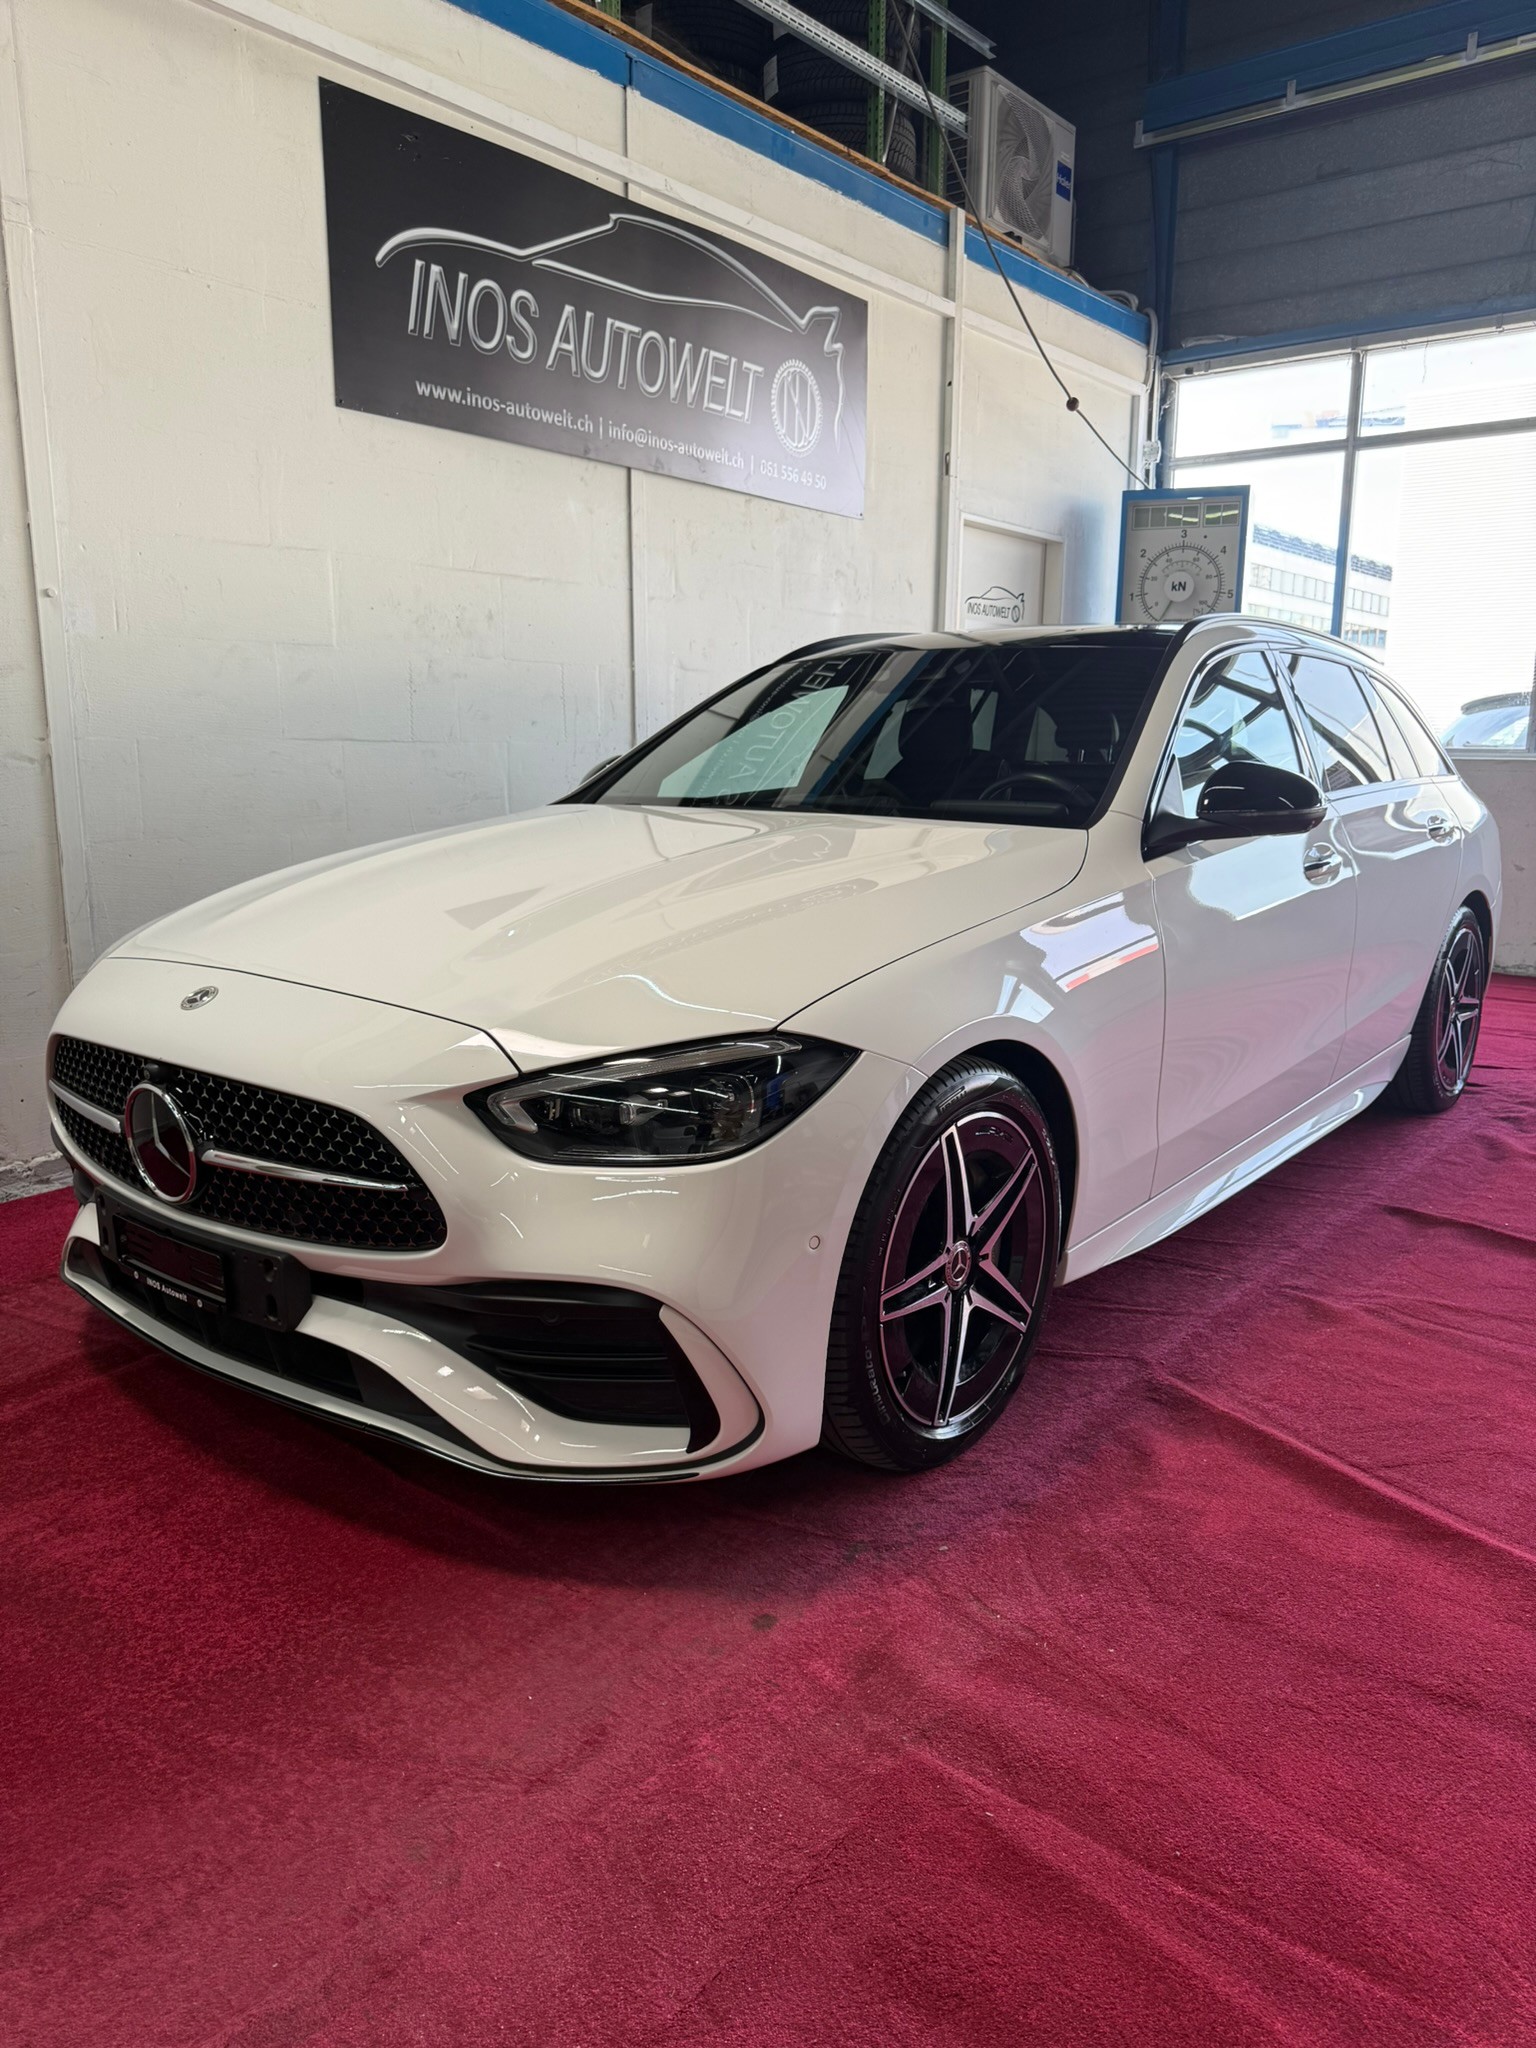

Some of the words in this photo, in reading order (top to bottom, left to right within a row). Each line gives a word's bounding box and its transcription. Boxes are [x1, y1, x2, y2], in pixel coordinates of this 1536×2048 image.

[408, 259, 539, 364] INOS
[546, 304, 765, 423] AUTOWELT
[415, 380, 593, 433] www.inos-autowelt.ch
[608, 421, 744, 470] info@inos-autowelt.ch
[781, 465, 799, 483] 556
[800, 469, 813, 487] 49
[814, 474, 827, 490] 50
[1181, 530, 1187, 538] 3
[1140, 549, 1147, 558] 2
[1220, 546, 1227, 554] 4
[1171, 581, 1187, 592] kN
[1129, 593, 1134, 601] 1
[1227, 589, 1234, 599] 5
